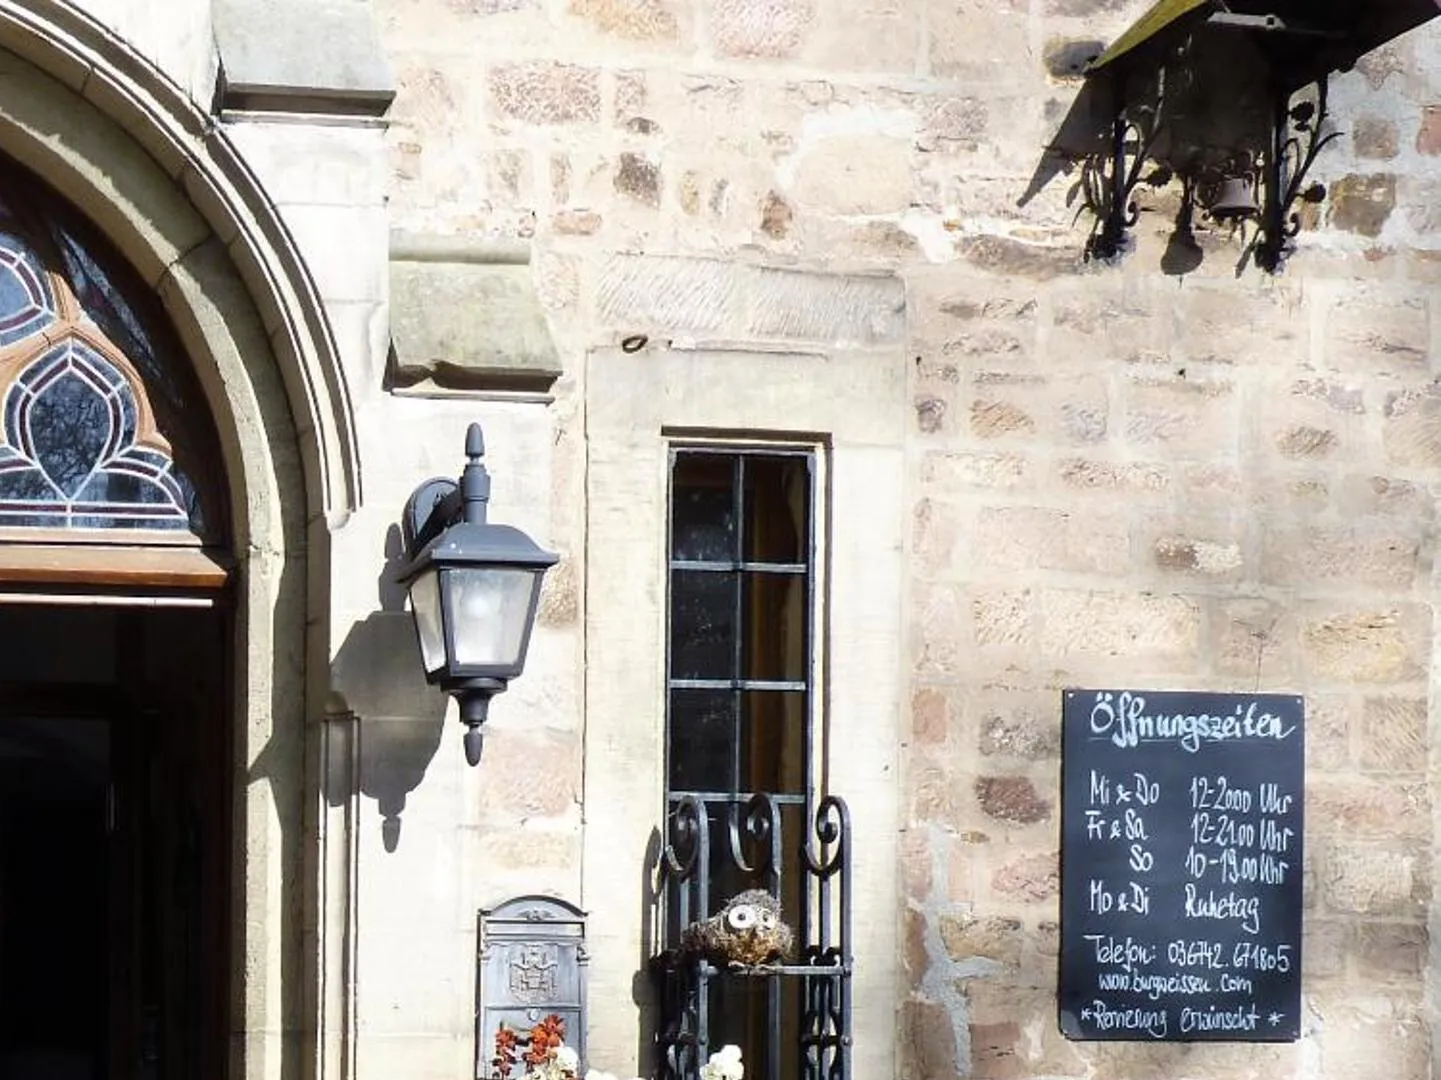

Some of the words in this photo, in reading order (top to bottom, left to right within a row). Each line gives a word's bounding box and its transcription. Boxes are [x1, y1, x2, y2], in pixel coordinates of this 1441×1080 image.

[1091, 692, 1296, 752] Öffnungszeiten
[1090, 770, 1110, 805] Mi
[1134, 772, 1160, 806] Do
[1260, 783, 1292, 814] Uhr
[1085, 810, 1106, 840] Fr
[1125, 808, 1149, 840] Sa
[1260, 817, 1294, 852] Uhr
[1129, 844, 1154, 872] So
[1260, 852, 1289, 884] Uhr
[1090, 879, 1111, 915] Mo
[1129, 881, 1149, 916] Di
[1185, 883, 1260, 934] Ruhetag
